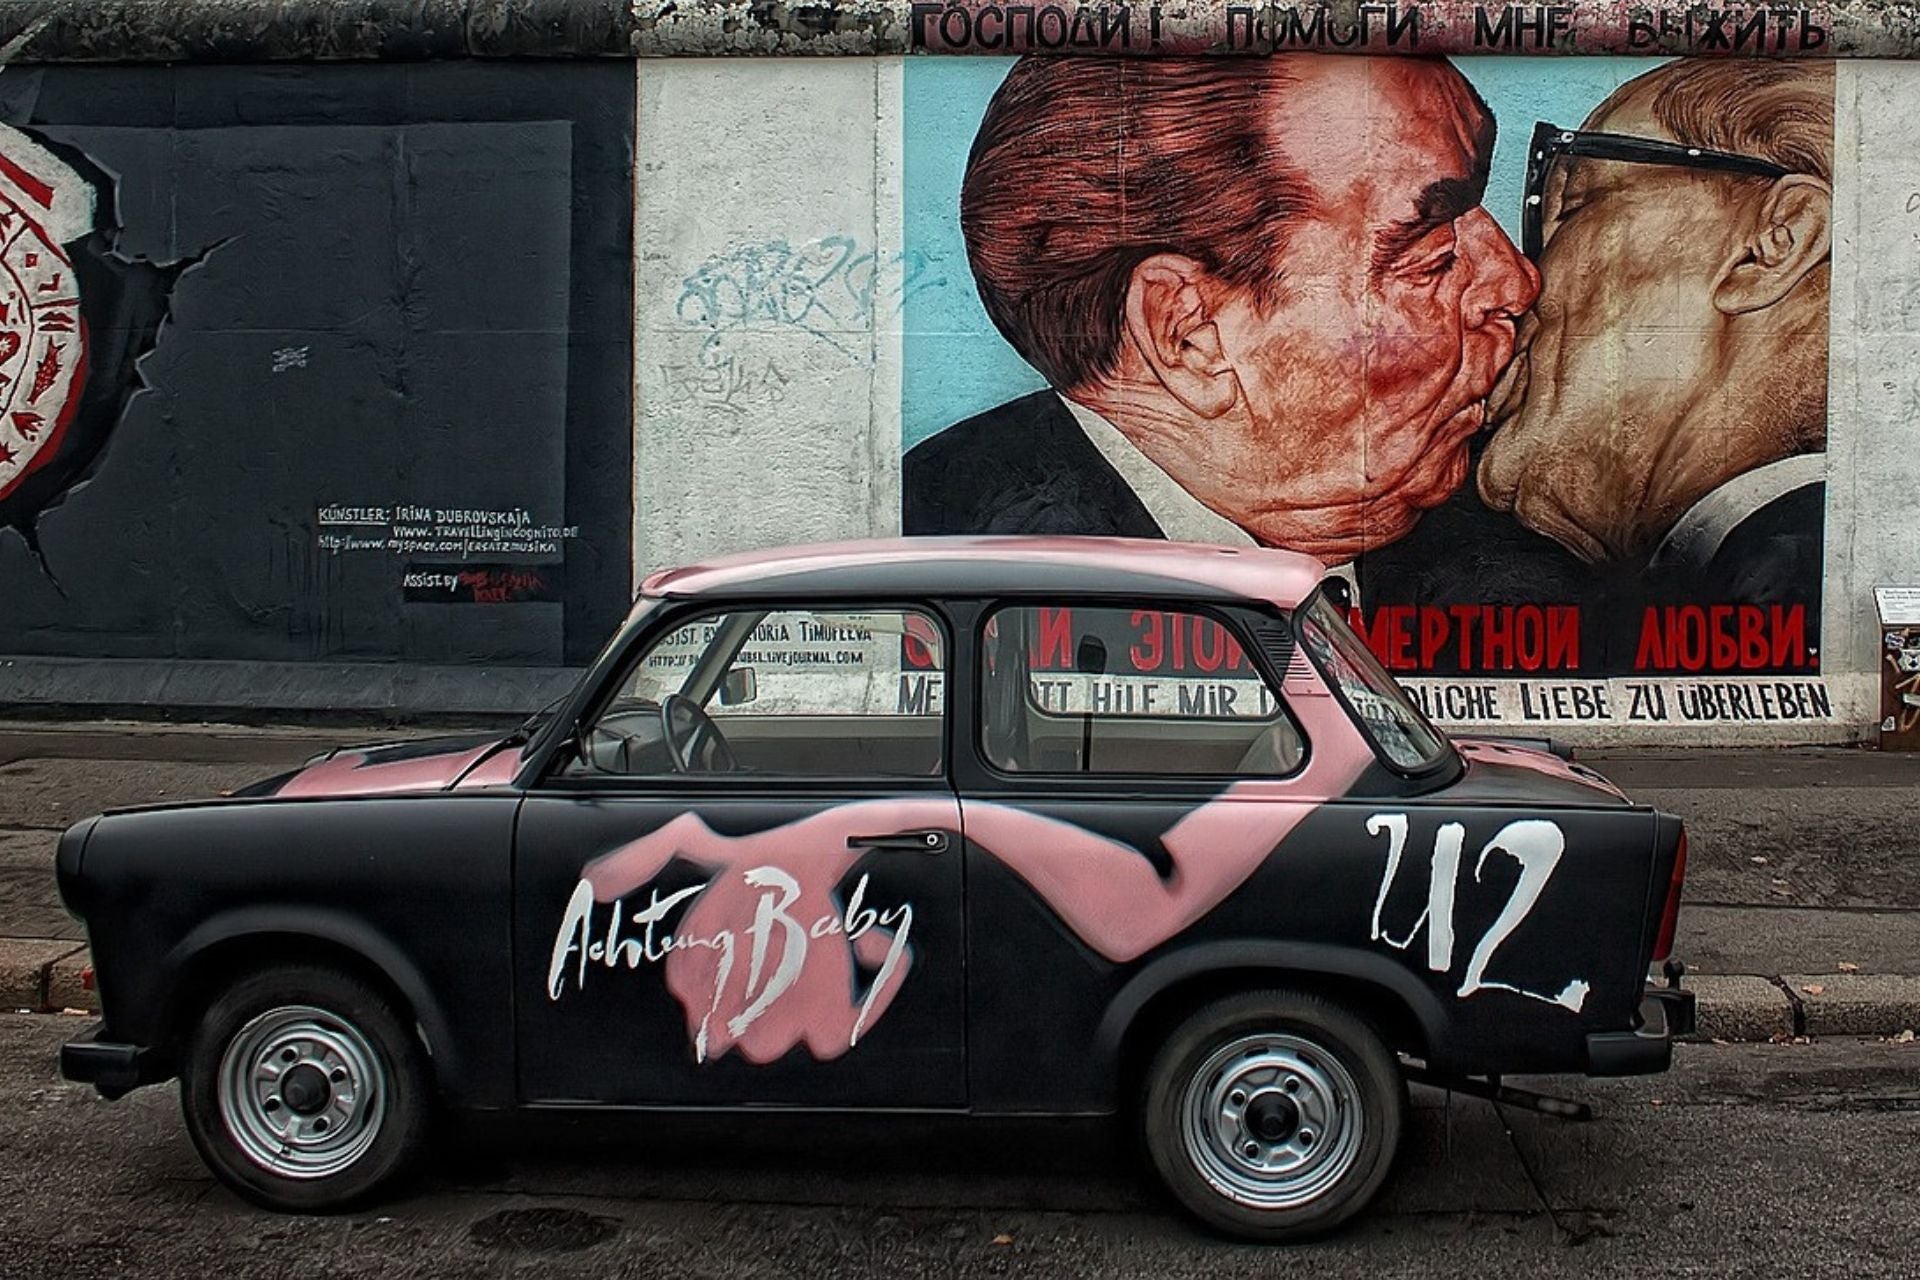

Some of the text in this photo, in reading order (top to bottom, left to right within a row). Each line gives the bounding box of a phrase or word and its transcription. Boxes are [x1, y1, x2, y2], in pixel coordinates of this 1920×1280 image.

[1627, 684, 1666, 721] ZU
[547, 865, 913, 1065] Achtung Baby
